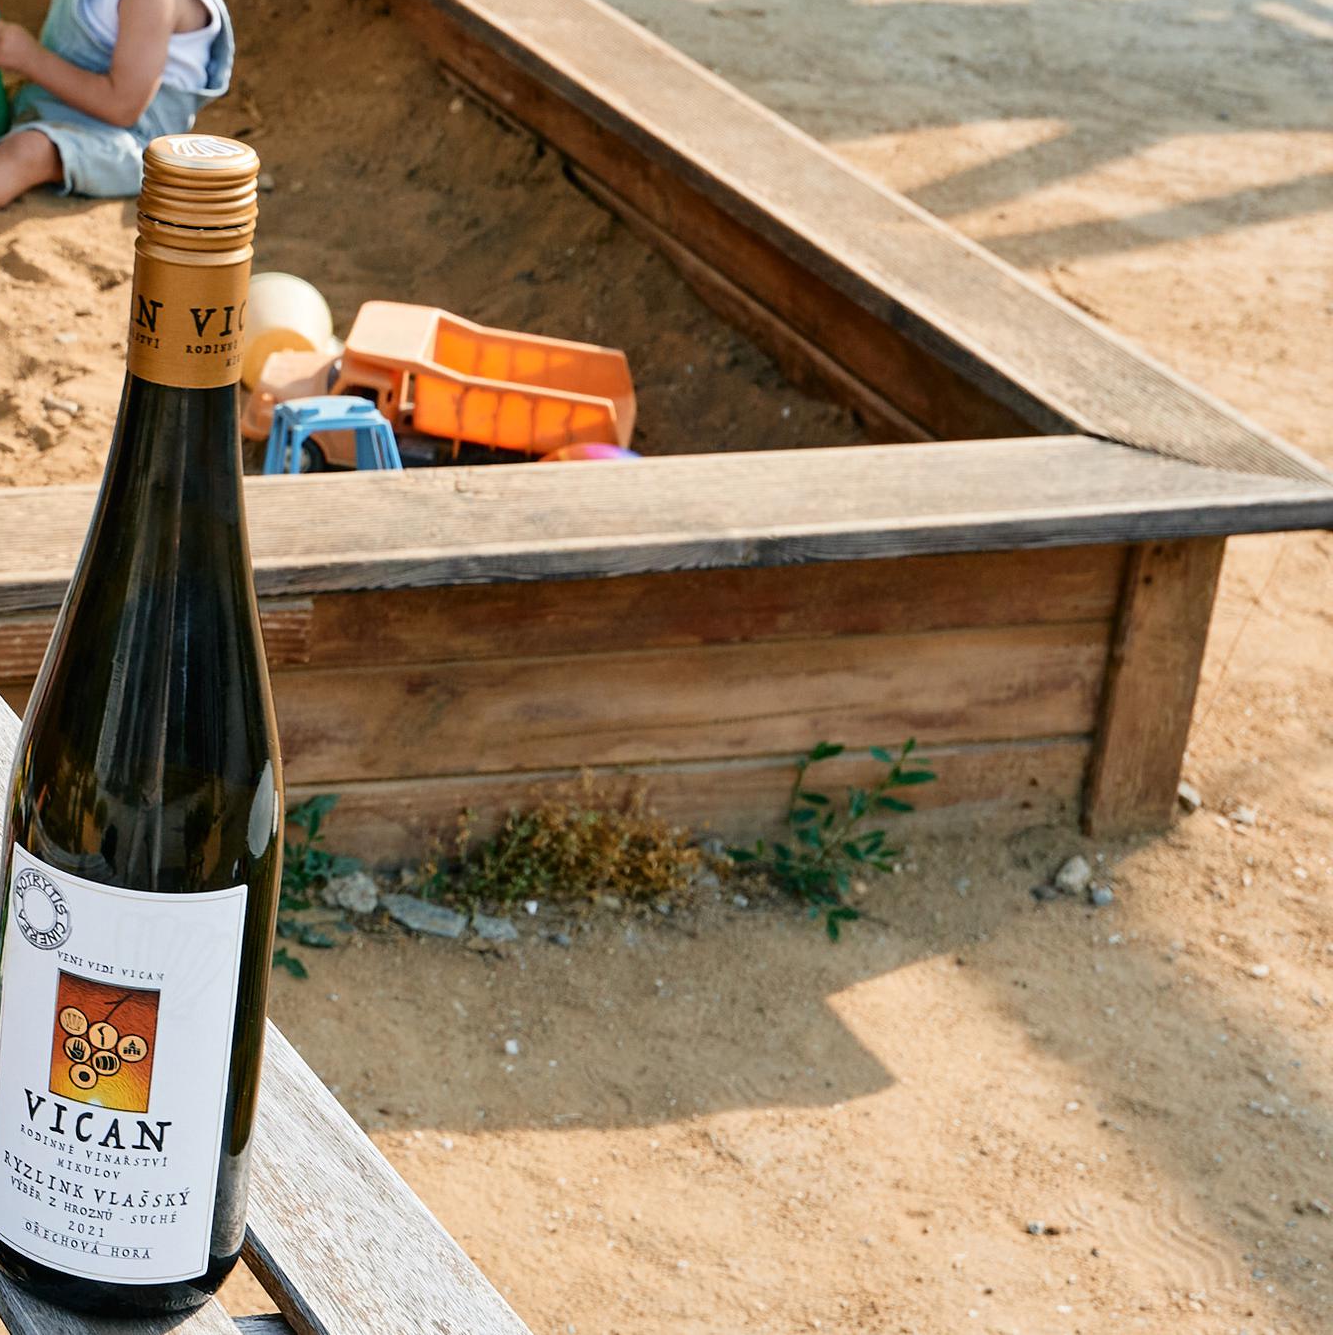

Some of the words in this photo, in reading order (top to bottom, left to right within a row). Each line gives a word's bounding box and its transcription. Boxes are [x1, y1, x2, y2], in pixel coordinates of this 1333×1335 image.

[57, 950, 83, 967] VENI
[88, 961, 114, 975] VIDI
[24, 1088, 172, 1153] VICAN
[4, 1150, 84, 1200] RYZLINK
[94, 1187, 190, 1208] VLAŠSKÝ
[57, 1157, 122, 1180] MIKULOV
[49, 1196, 57, 1208] Z
[130, 1210, 178, 1225] SUCHÉ
[68, 1220, 104, 1238] 2021
[111, 1247, 151, 1260] HORA
